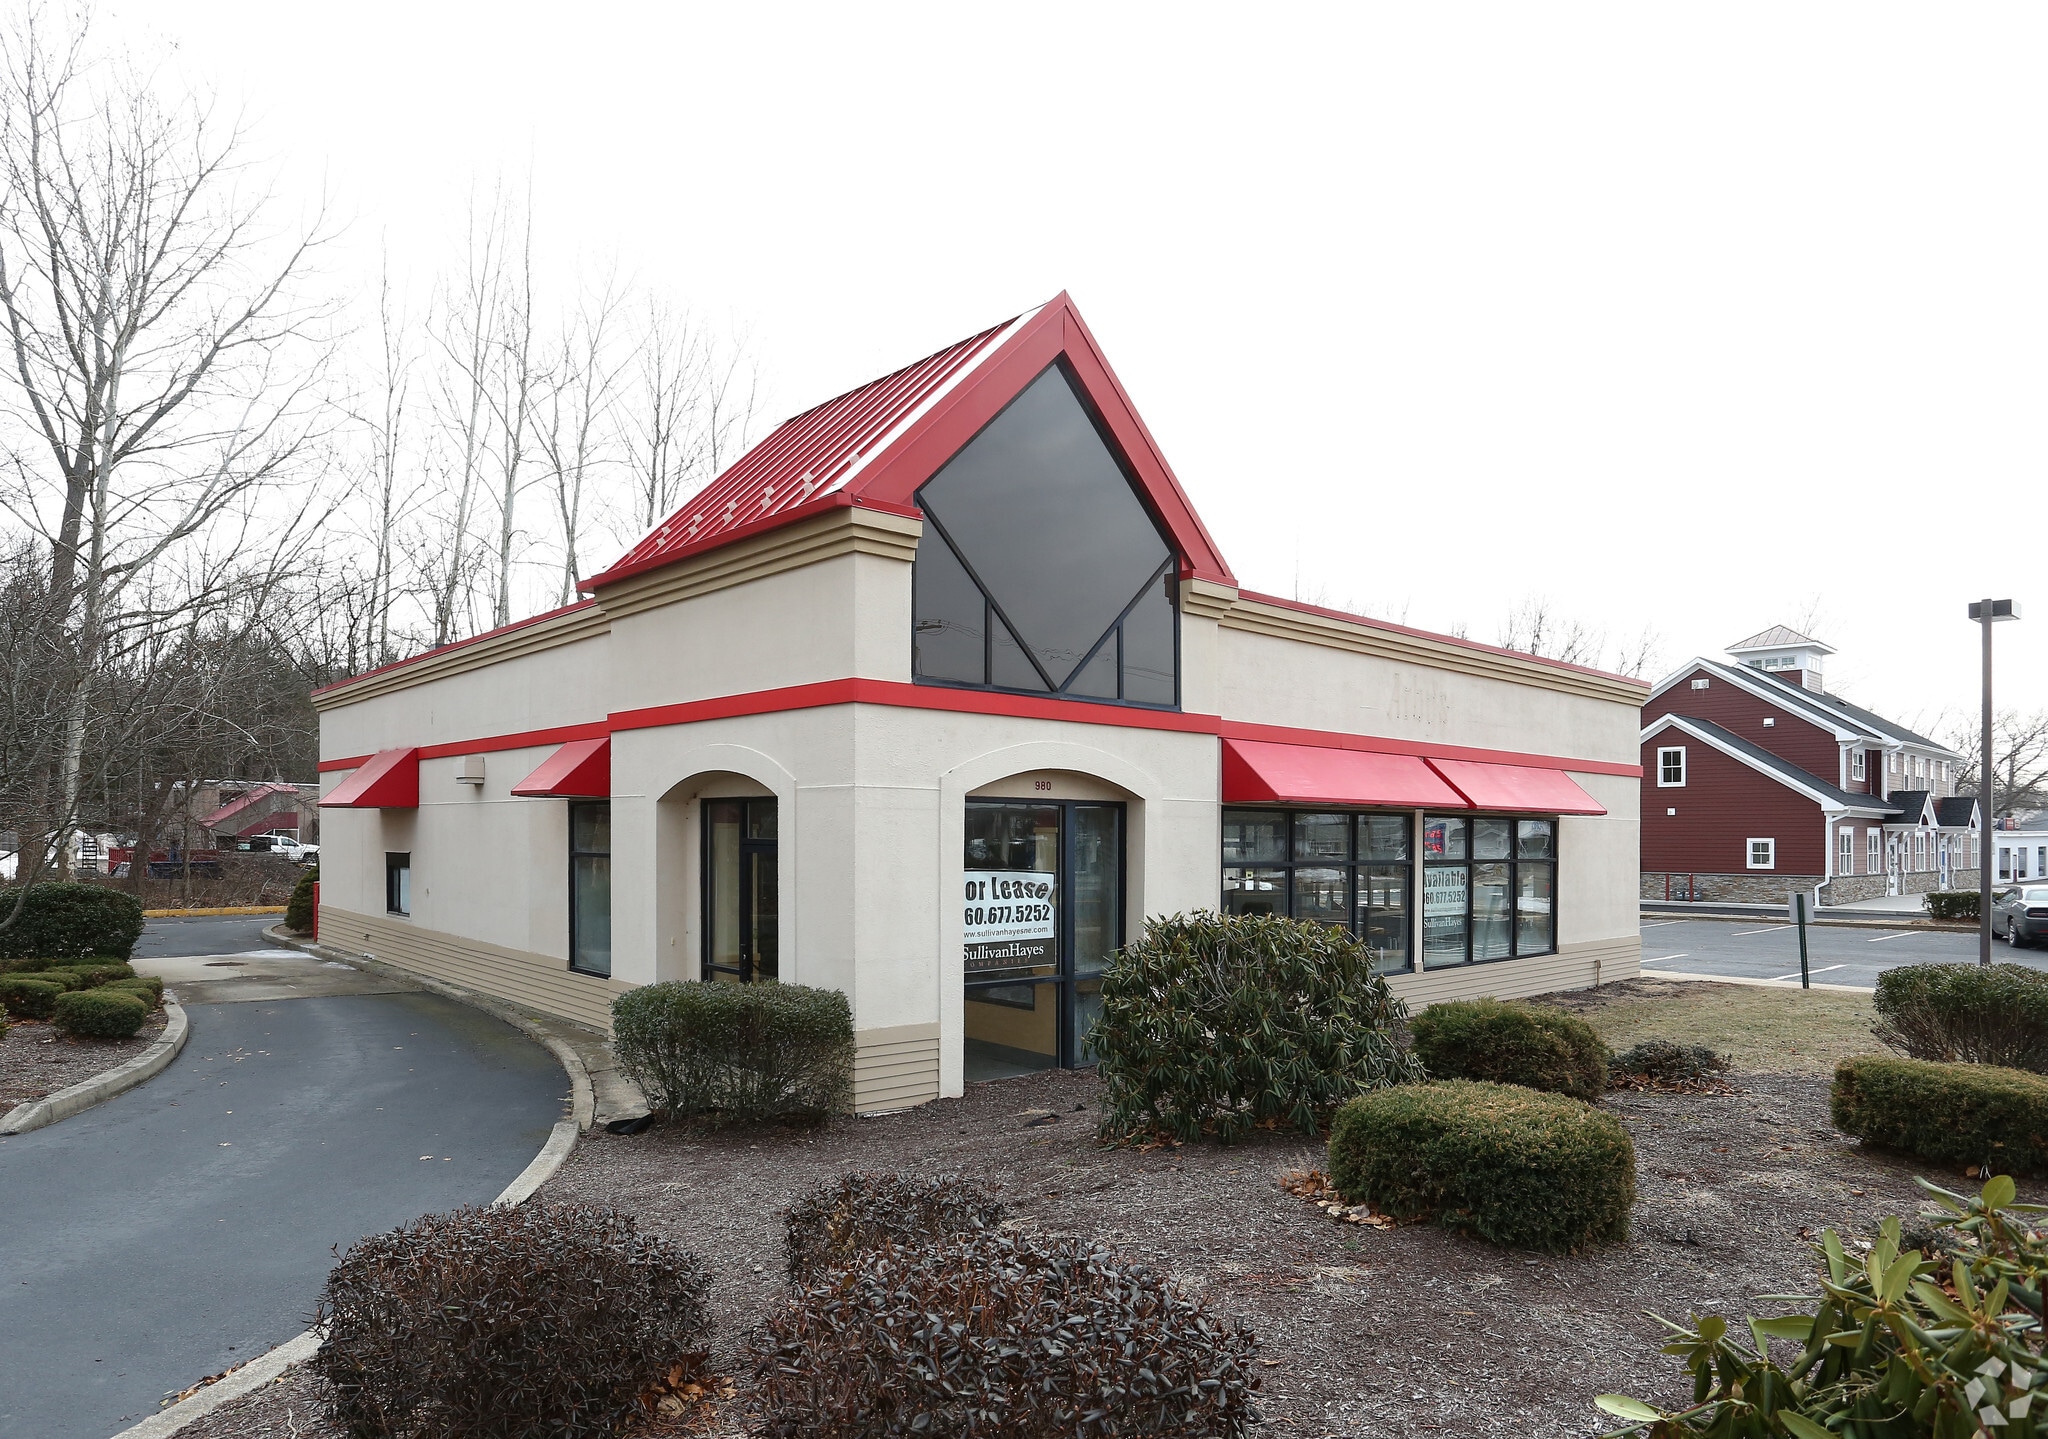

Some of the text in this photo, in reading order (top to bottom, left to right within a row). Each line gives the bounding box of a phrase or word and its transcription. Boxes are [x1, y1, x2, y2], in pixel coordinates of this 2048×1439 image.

[1035, 781, 1051, 790] 980
[965, 877, 1049, 901] or Lease
[1424, 890, 1466, 904] 60.677.5252
[964, 904, 1051, 926] 60.677.5252
[964, 926, 1049, 938] ww.sullivanhayesne.com
